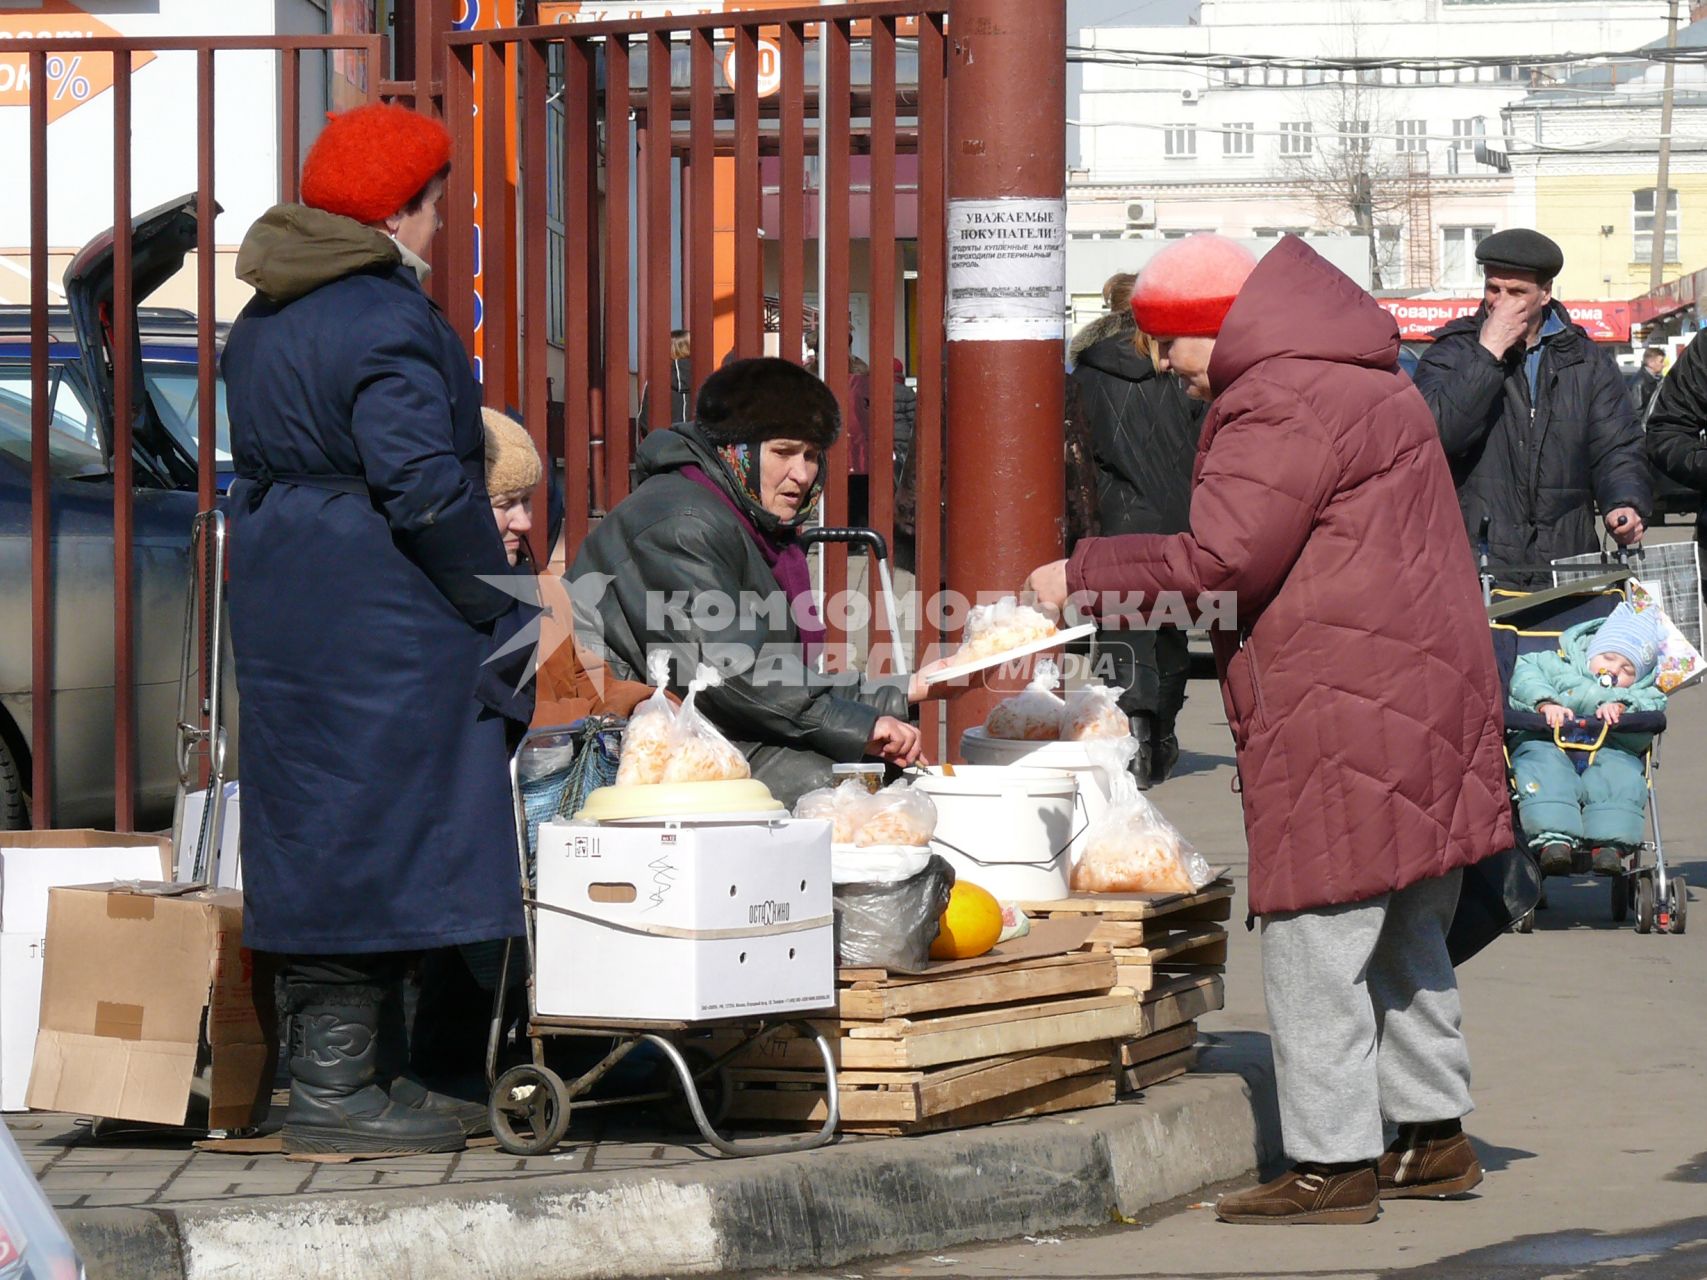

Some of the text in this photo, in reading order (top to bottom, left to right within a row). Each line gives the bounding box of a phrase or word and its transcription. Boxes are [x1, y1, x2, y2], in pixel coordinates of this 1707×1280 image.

[966, 211, 1055, 224] УВАЖАЕМЫЕ
[960, 228, 1057, 240] ПОКУПАТЕЛИ!
[1388, 304, 1452, 321] Товары
[1566, 307, 1602, 320] ома
